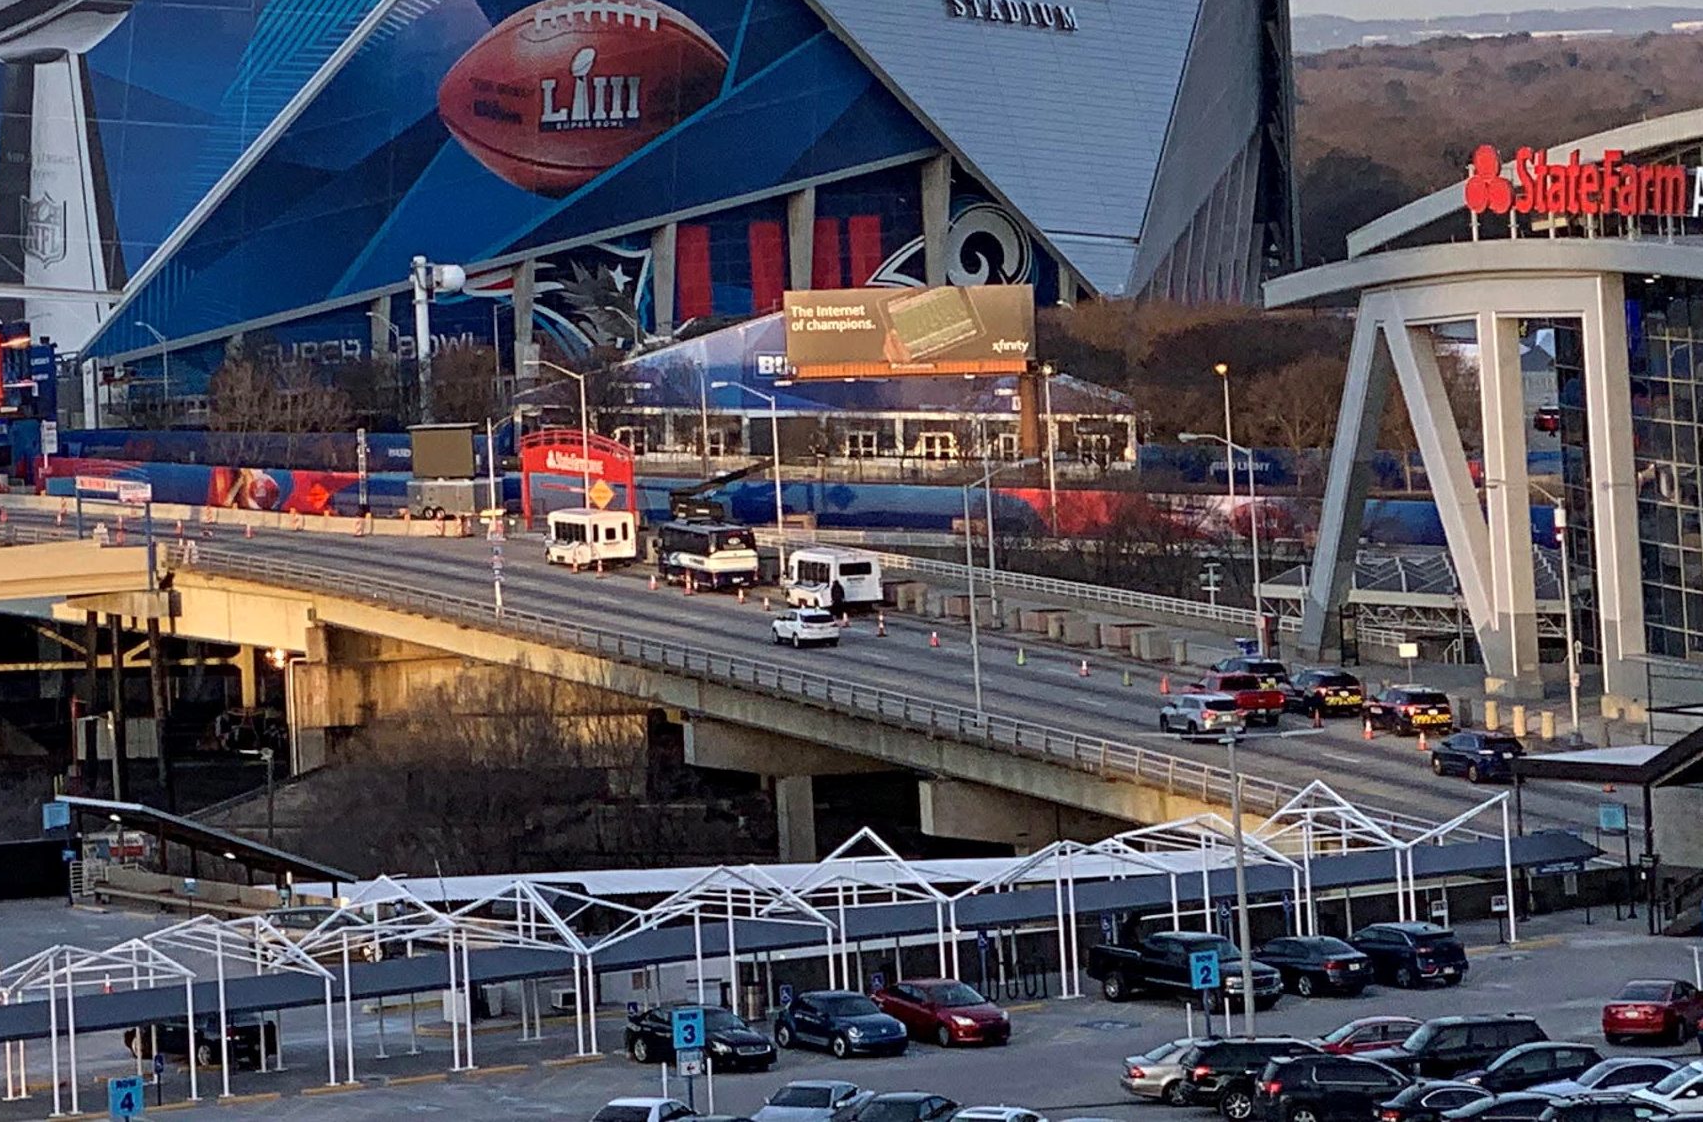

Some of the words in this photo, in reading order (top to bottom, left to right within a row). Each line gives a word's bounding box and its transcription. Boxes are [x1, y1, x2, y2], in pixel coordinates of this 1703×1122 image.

[26, 225, 60, 256] NFL
[790, 305, 814, 318] The
[816, 304, 866, 318] Internet
[791, 318, 804, 332] of
[806, 318, 876, 333] champions.
[992, 338, 1029, 354] xfinity
[1199, 965, 1213, 985] 2
[683, 1024, 696, 1044] 3
[120, 1091, 135, 1113] 4
